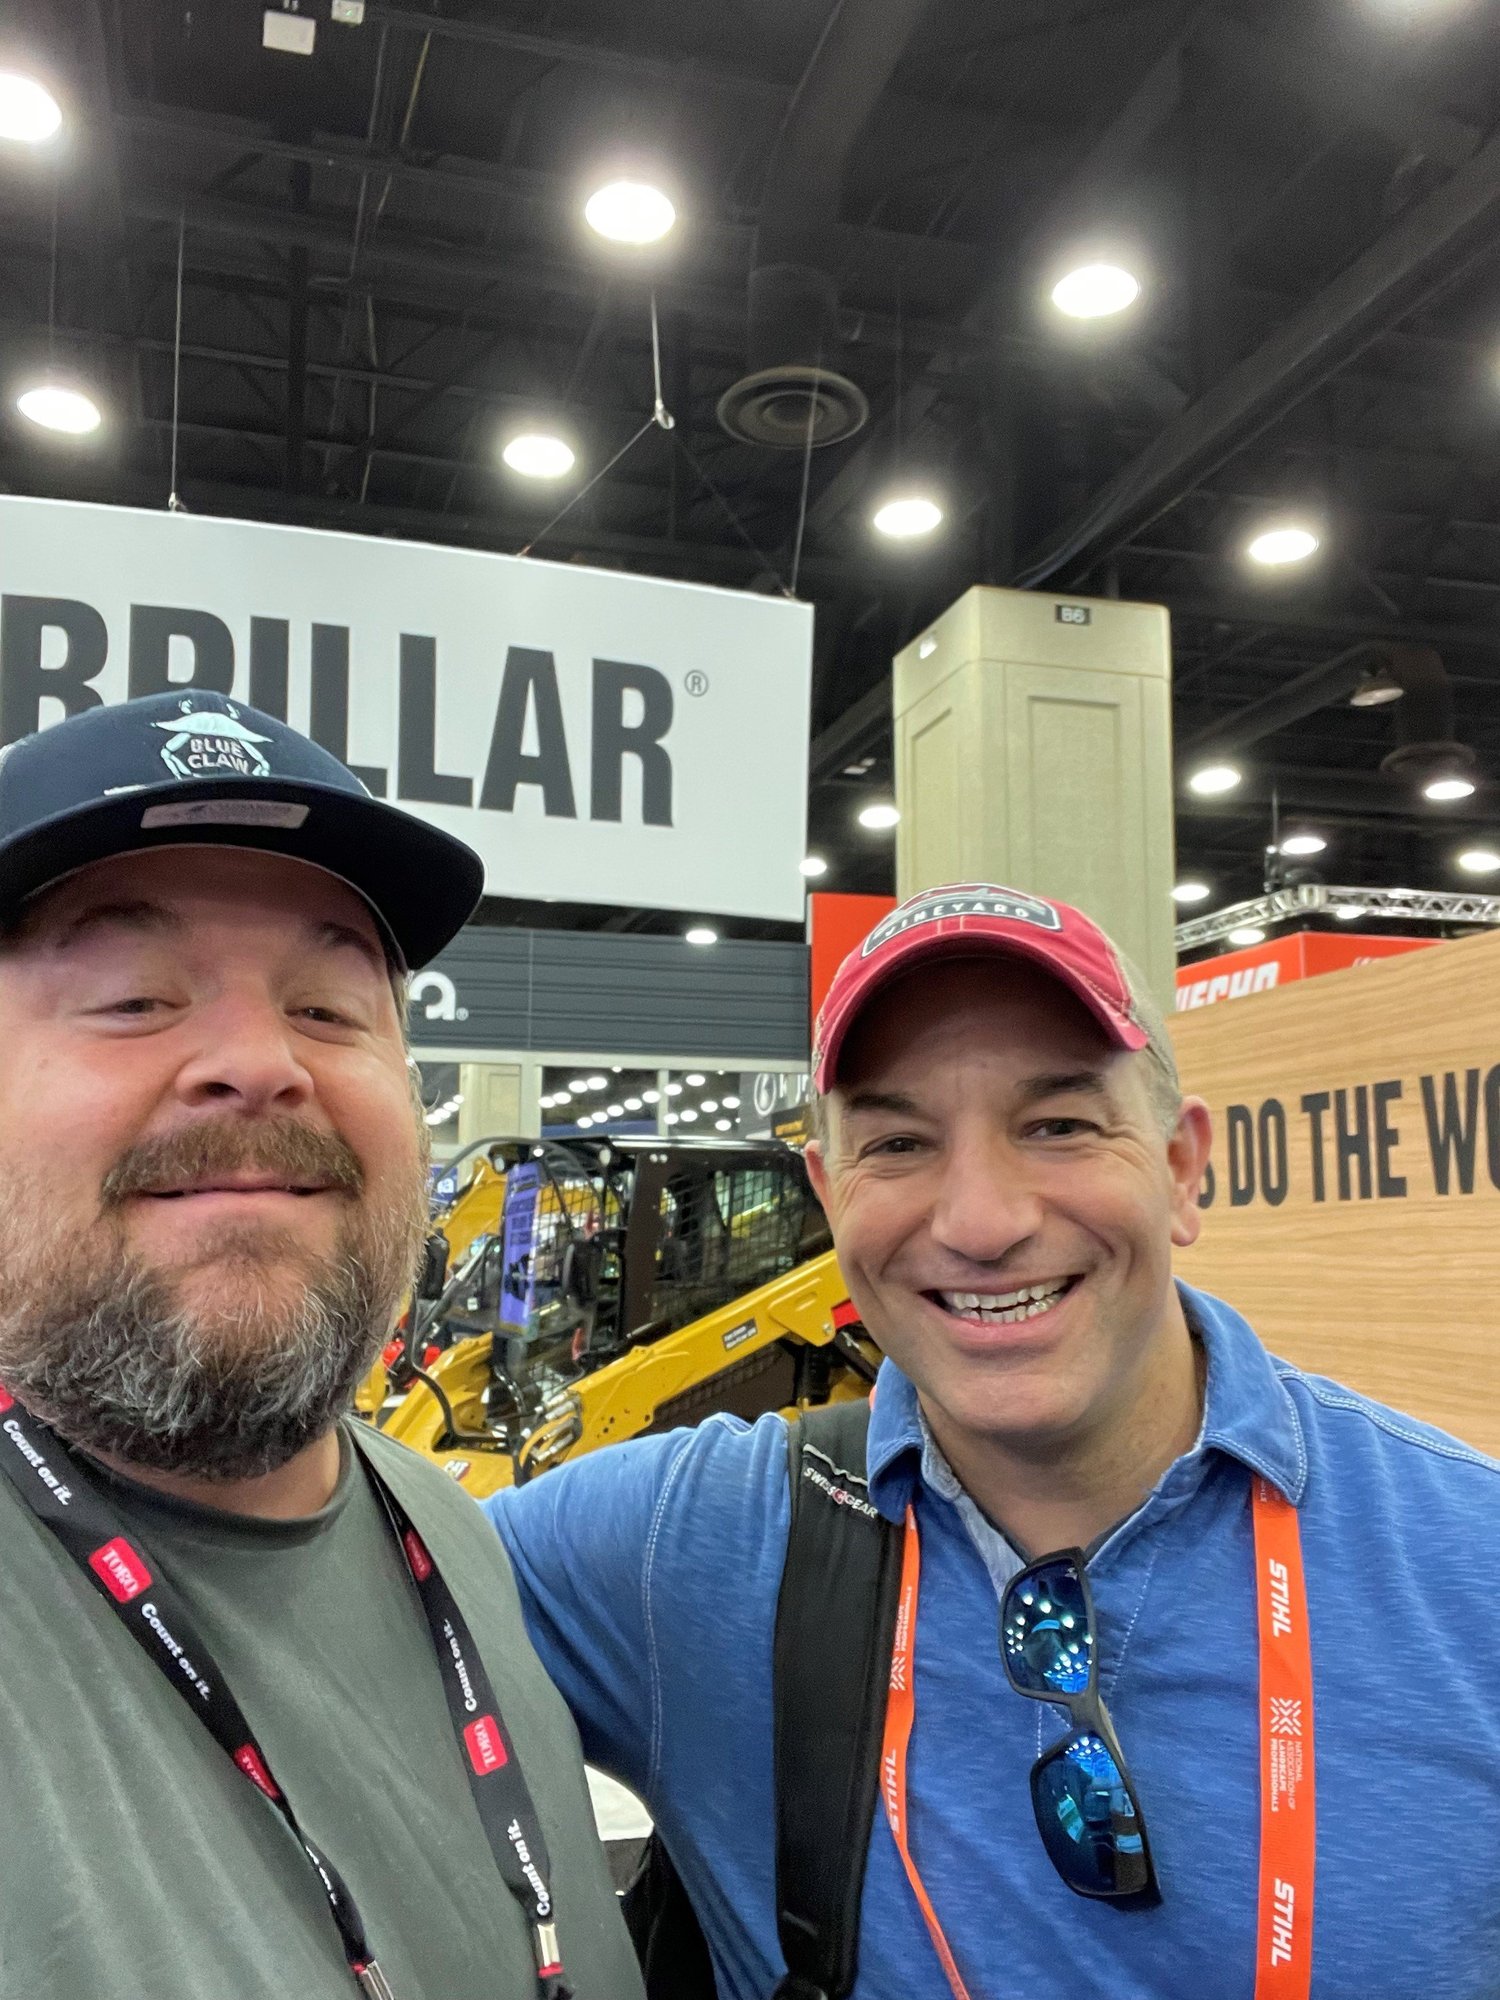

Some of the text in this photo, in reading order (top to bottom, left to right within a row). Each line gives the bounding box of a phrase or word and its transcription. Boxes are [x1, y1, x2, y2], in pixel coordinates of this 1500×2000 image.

[187, 753, 249, 774] CLAW
[190, 738, 246, 758] BLUE
[885, 902, 1029, 937] VINEYARD
[1227, 1098, 1288, 1207] DO
[1301, 1080, 1407, 1202] THE
[3, 1419, 45, 1468] Count
[38, 1466, 60, 1488] on
[102, 1547, 139, 1594] TORO
[1269, 1558, 1291, 1638] STIHL
[142, 1603, 184, 1658] Count
[178, 1657, 198, 1680] on
[450, 1637, 461, 1659] on
[455, 1659, 477, 1712] Count
[474, 1718, 497, 1768] TORO
[1279, 1739, 1287, 1792] LANDSCAPE
[1294, 1741, 1302, 1783] NATIONAL
[885, 1748, 899, 1833] STIHL
[1270, 1738, 1279, 1812] PROFESSIONALS
[1287, 1740, 1296, 1810] ASSOCIATION OF
[515, 1839, 530, 1863] on
[522, 1863, 550, 1916] Count
[1271, 1877, 1294, 1967] STIHL
